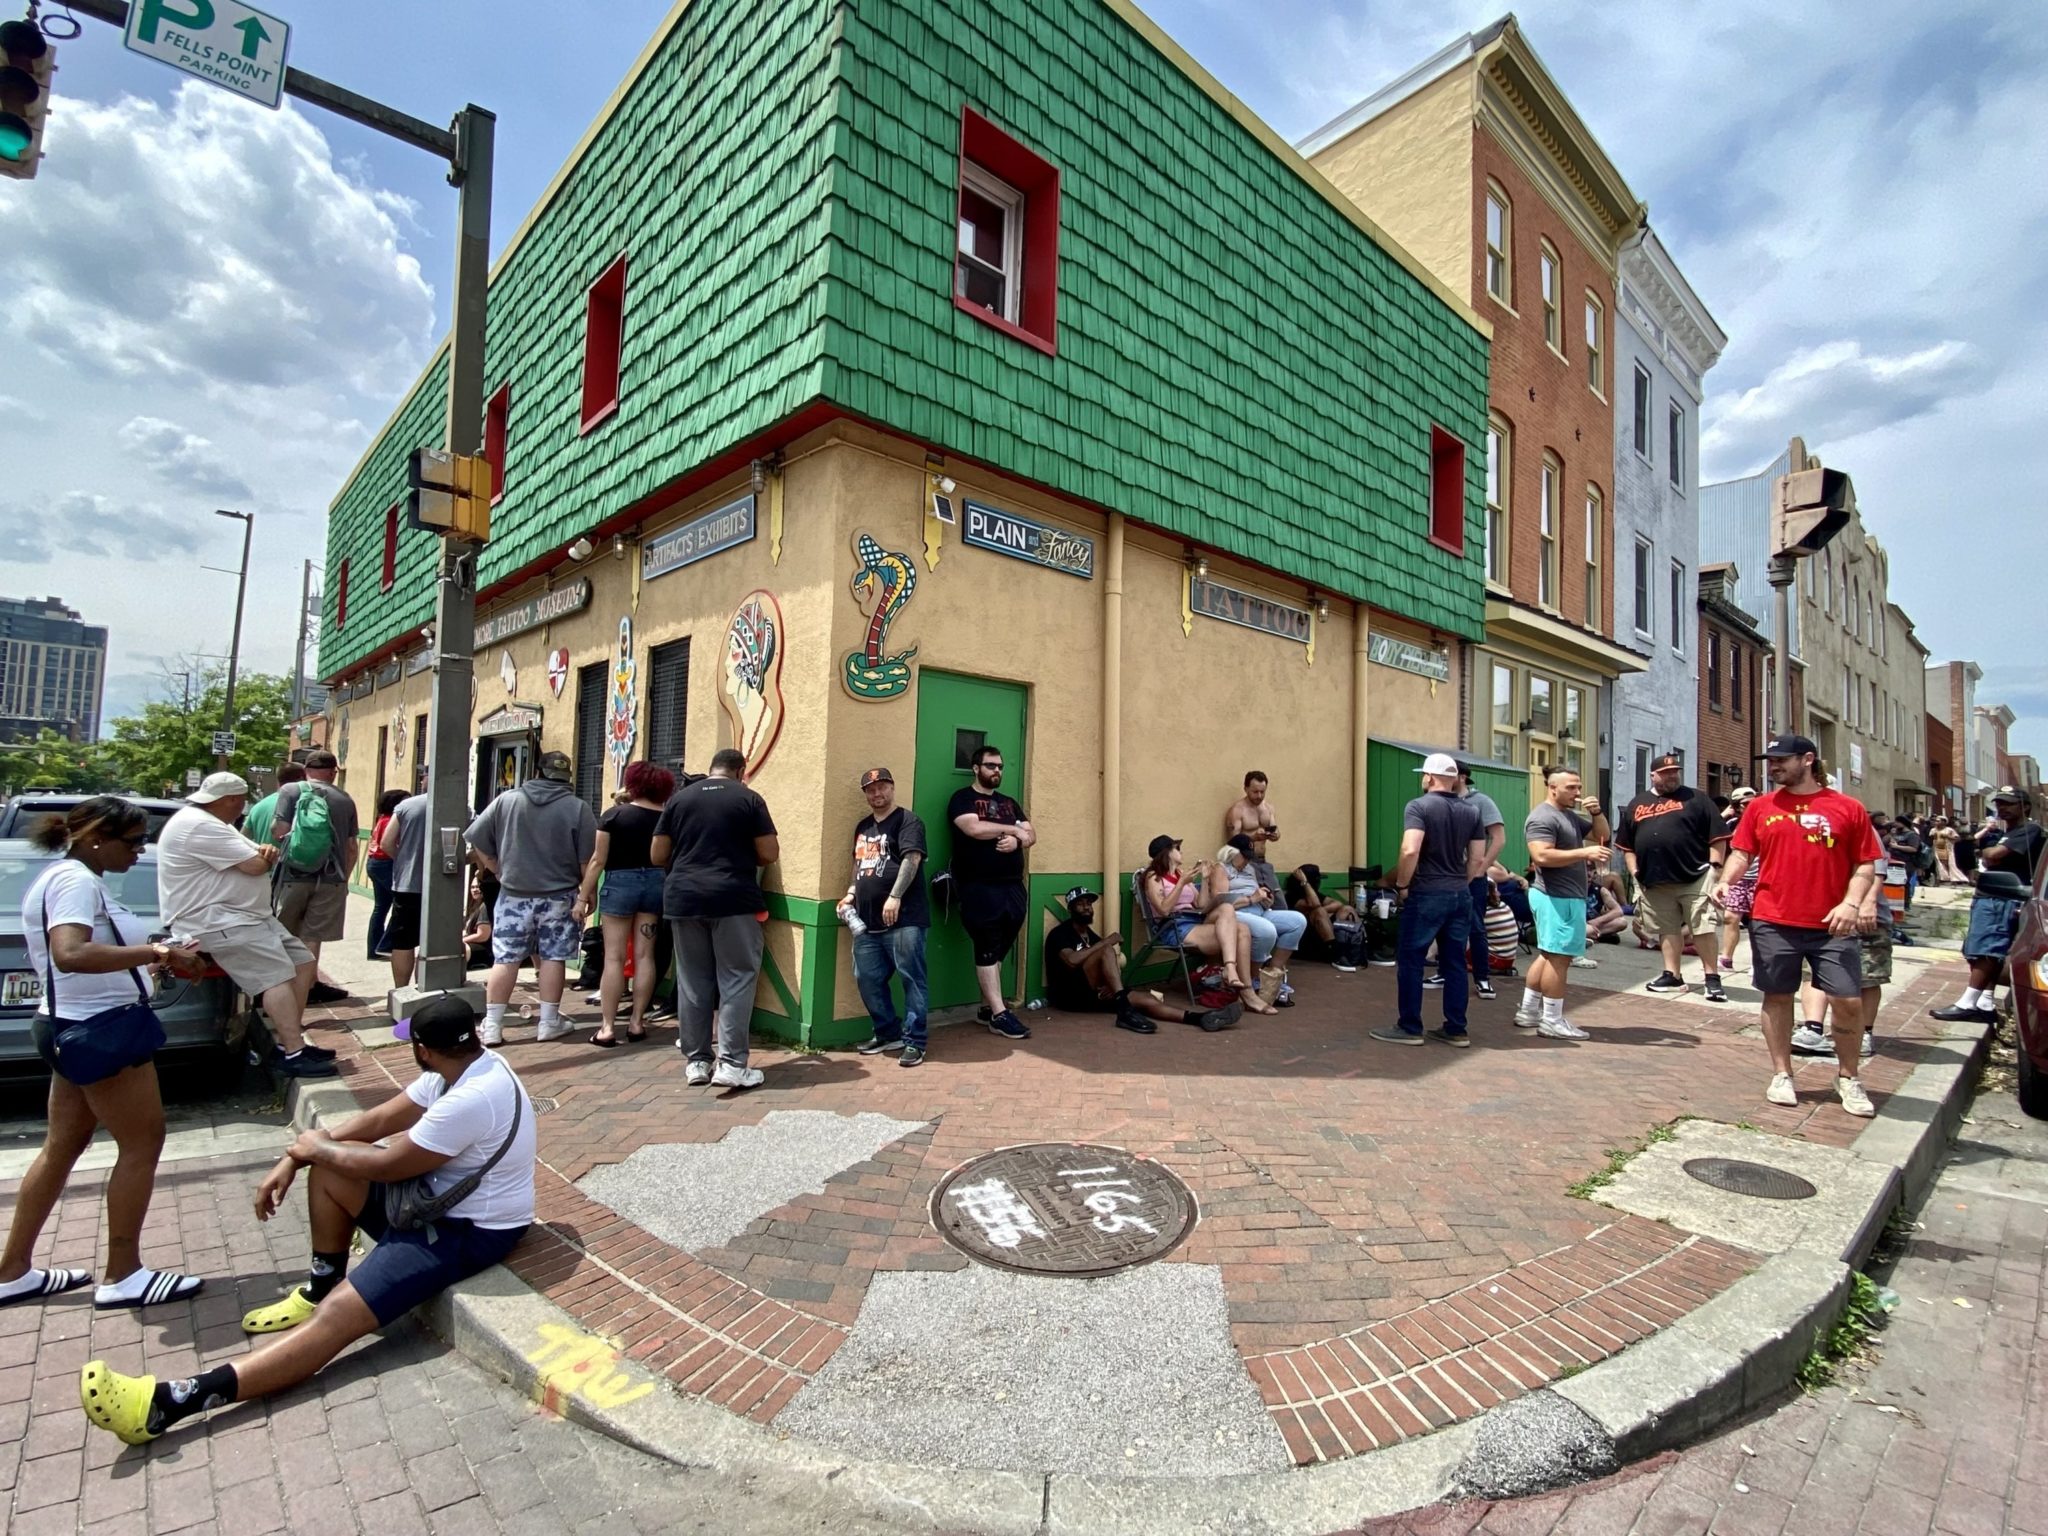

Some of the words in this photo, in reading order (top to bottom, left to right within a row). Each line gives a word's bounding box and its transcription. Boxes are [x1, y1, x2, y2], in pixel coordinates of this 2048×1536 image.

[137, 0, 215, 44] P
[163, 30, 214, 59] FELLS
[216, 52, 273, 83] POINT
[178, 55, 251, 90] PARKING
[645, 532, 694, 572] ARTIFACTS
[698, 507, 748, 549] EXHIBITS
[970, 511, 1026, 549] PLAIN
[1040, 528, 1089, 569] Fancy
[498, 606, 530, 637] TATTOO
[534, 583, 582, 622] MUSEUM
[1195, 581, 1309, 639] TATTOO
[1369, 637, 1404, 665] BODY
[481, 711, 537, 733] WELCOME
